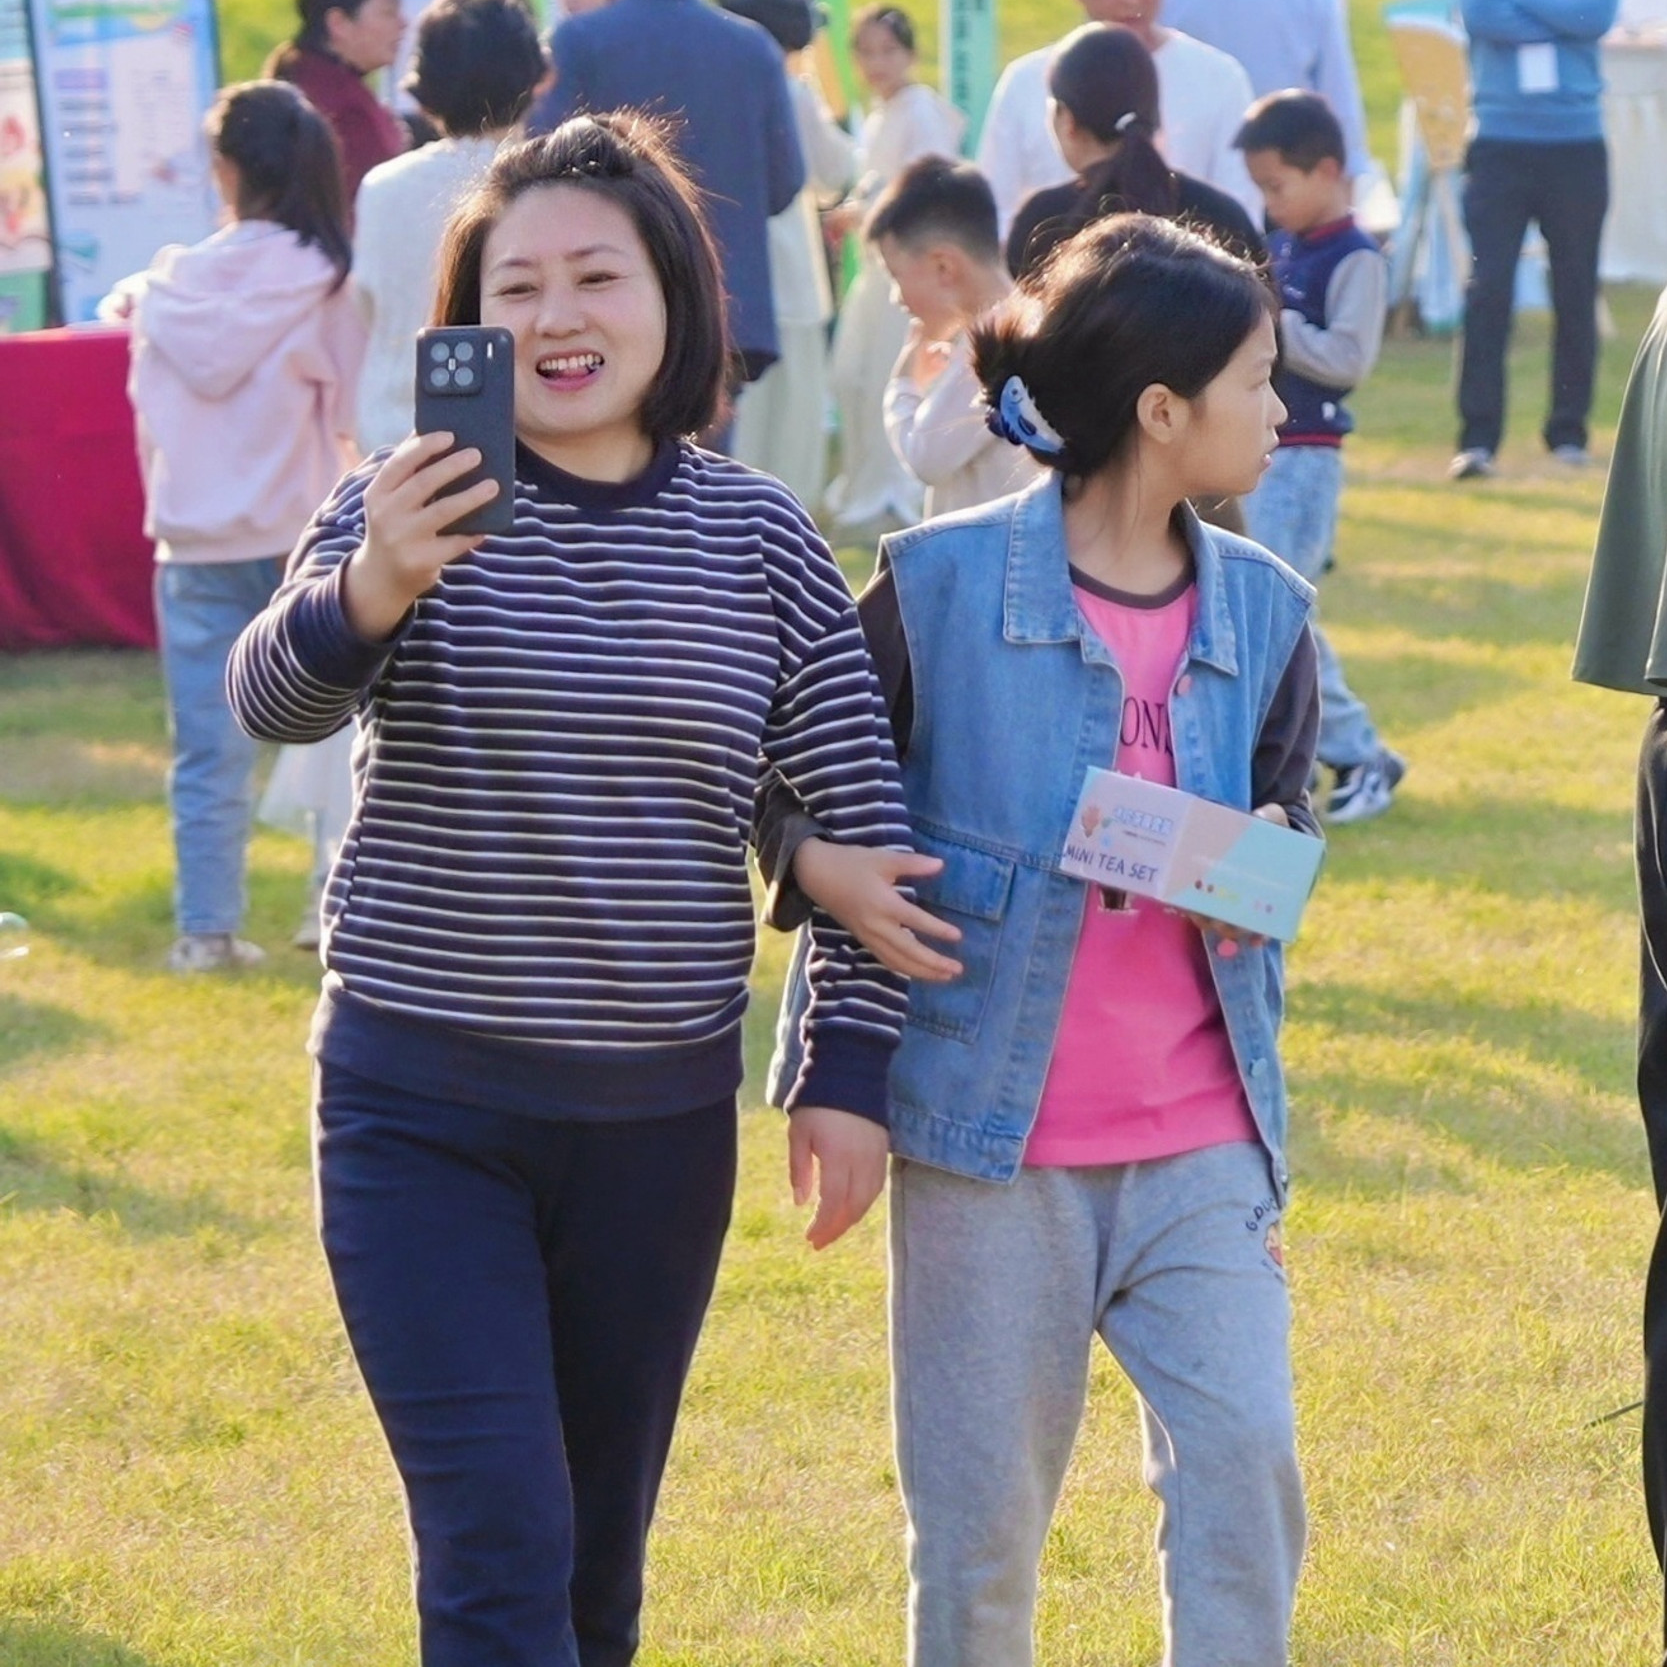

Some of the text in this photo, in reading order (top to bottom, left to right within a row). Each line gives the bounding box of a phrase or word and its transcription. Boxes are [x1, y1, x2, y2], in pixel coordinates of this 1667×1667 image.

[1064, 843, 1158, 883] MINI TEA SET
